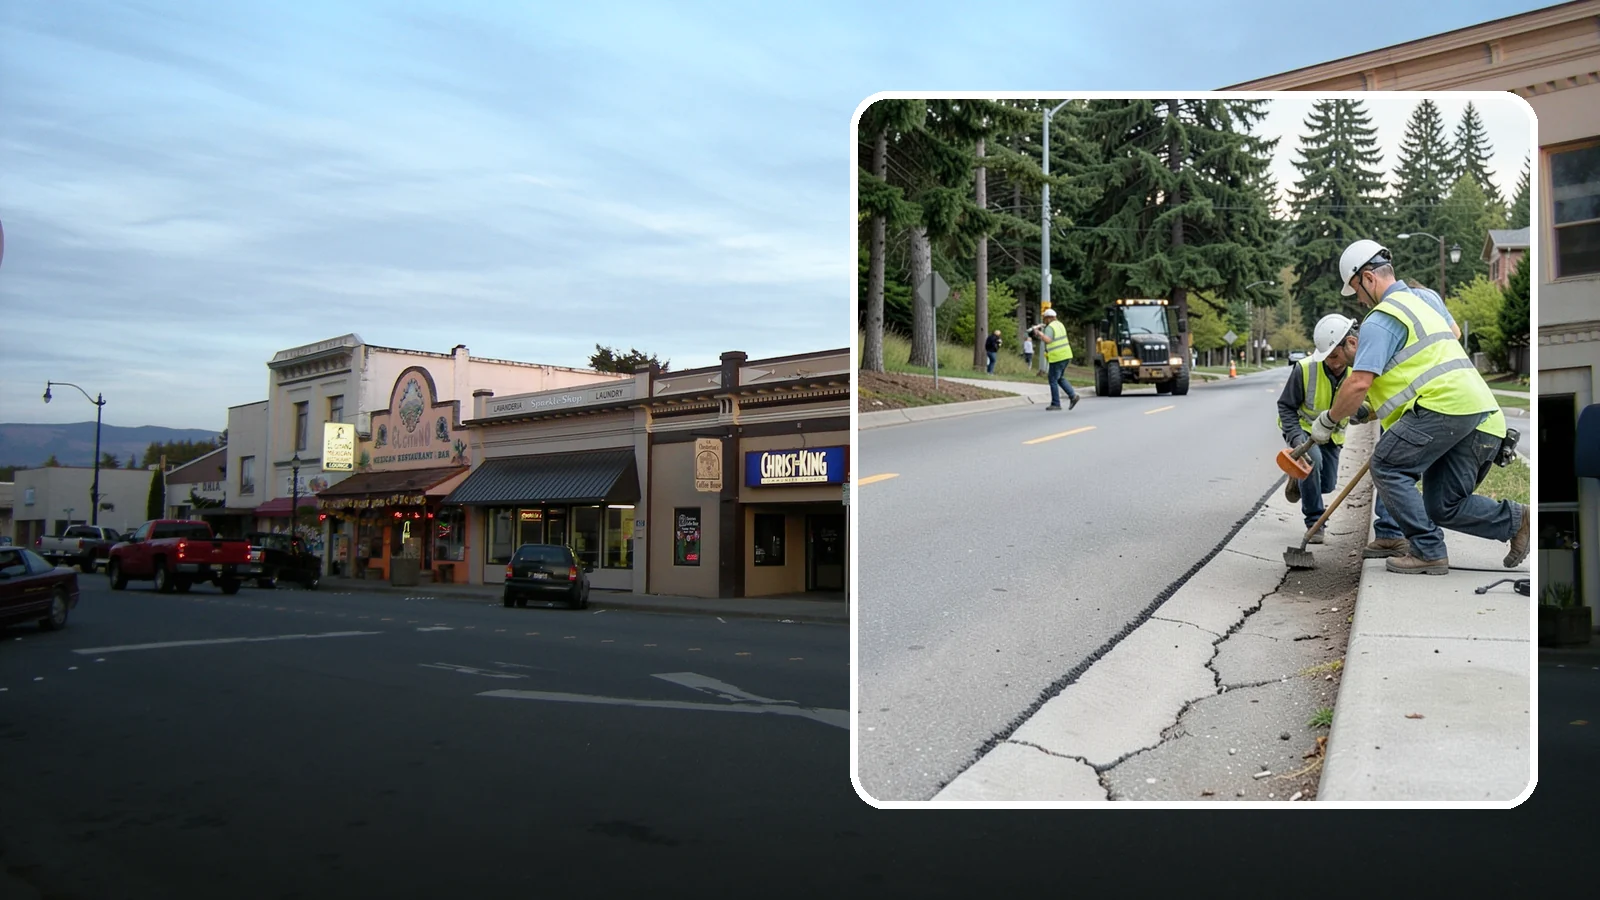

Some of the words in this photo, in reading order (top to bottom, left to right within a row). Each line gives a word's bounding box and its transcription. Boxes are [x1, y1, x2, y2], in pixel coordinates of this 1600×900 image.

[493, 402, 522, 413] LAVANDERIA
[530, 397, 561, 409] Sparkle
[562, 394, 582, 406] Shop
[595, 389, 623, 400] LAUNDRY
[373, 455, 396, 464] MEXICAN
[397, 451, 433, 462] RESTAURANT
[438, 450, 450, 459] BAR
[760, 451, 798, 478] CHRIST
[799, 449, 827, 476] KING
[696, 480, 709, 489] Coffee
[710, 480, 722, 489] House
